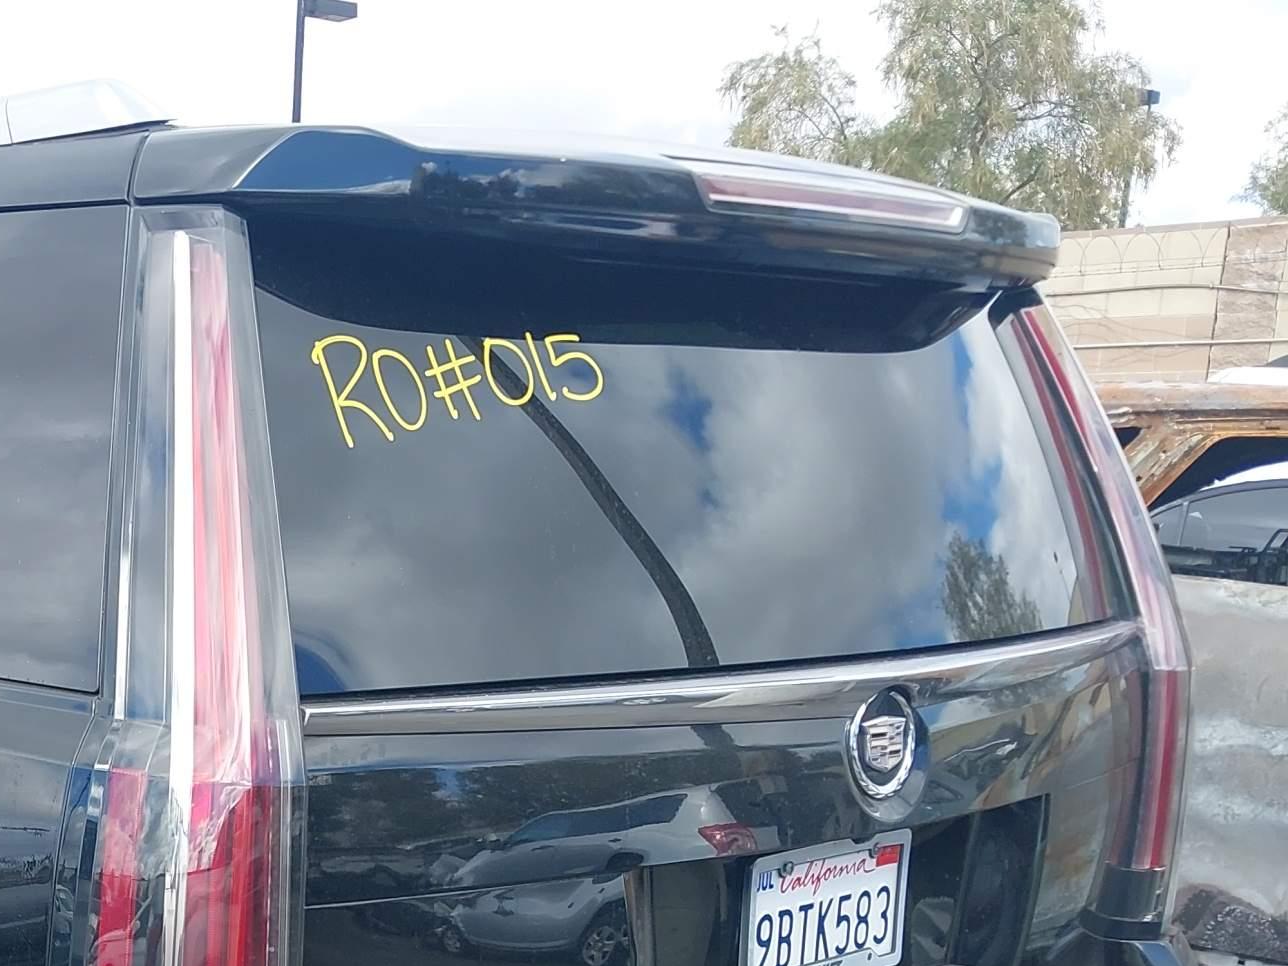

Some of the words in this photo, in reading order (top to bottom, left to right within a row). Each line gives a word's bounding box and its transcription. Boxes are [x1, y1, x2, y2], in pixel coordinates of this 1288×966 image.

[311, 331, 604, 448] RO#015
[757, 872, 774, 892] JUL
[779, 858, 875, 896] California
